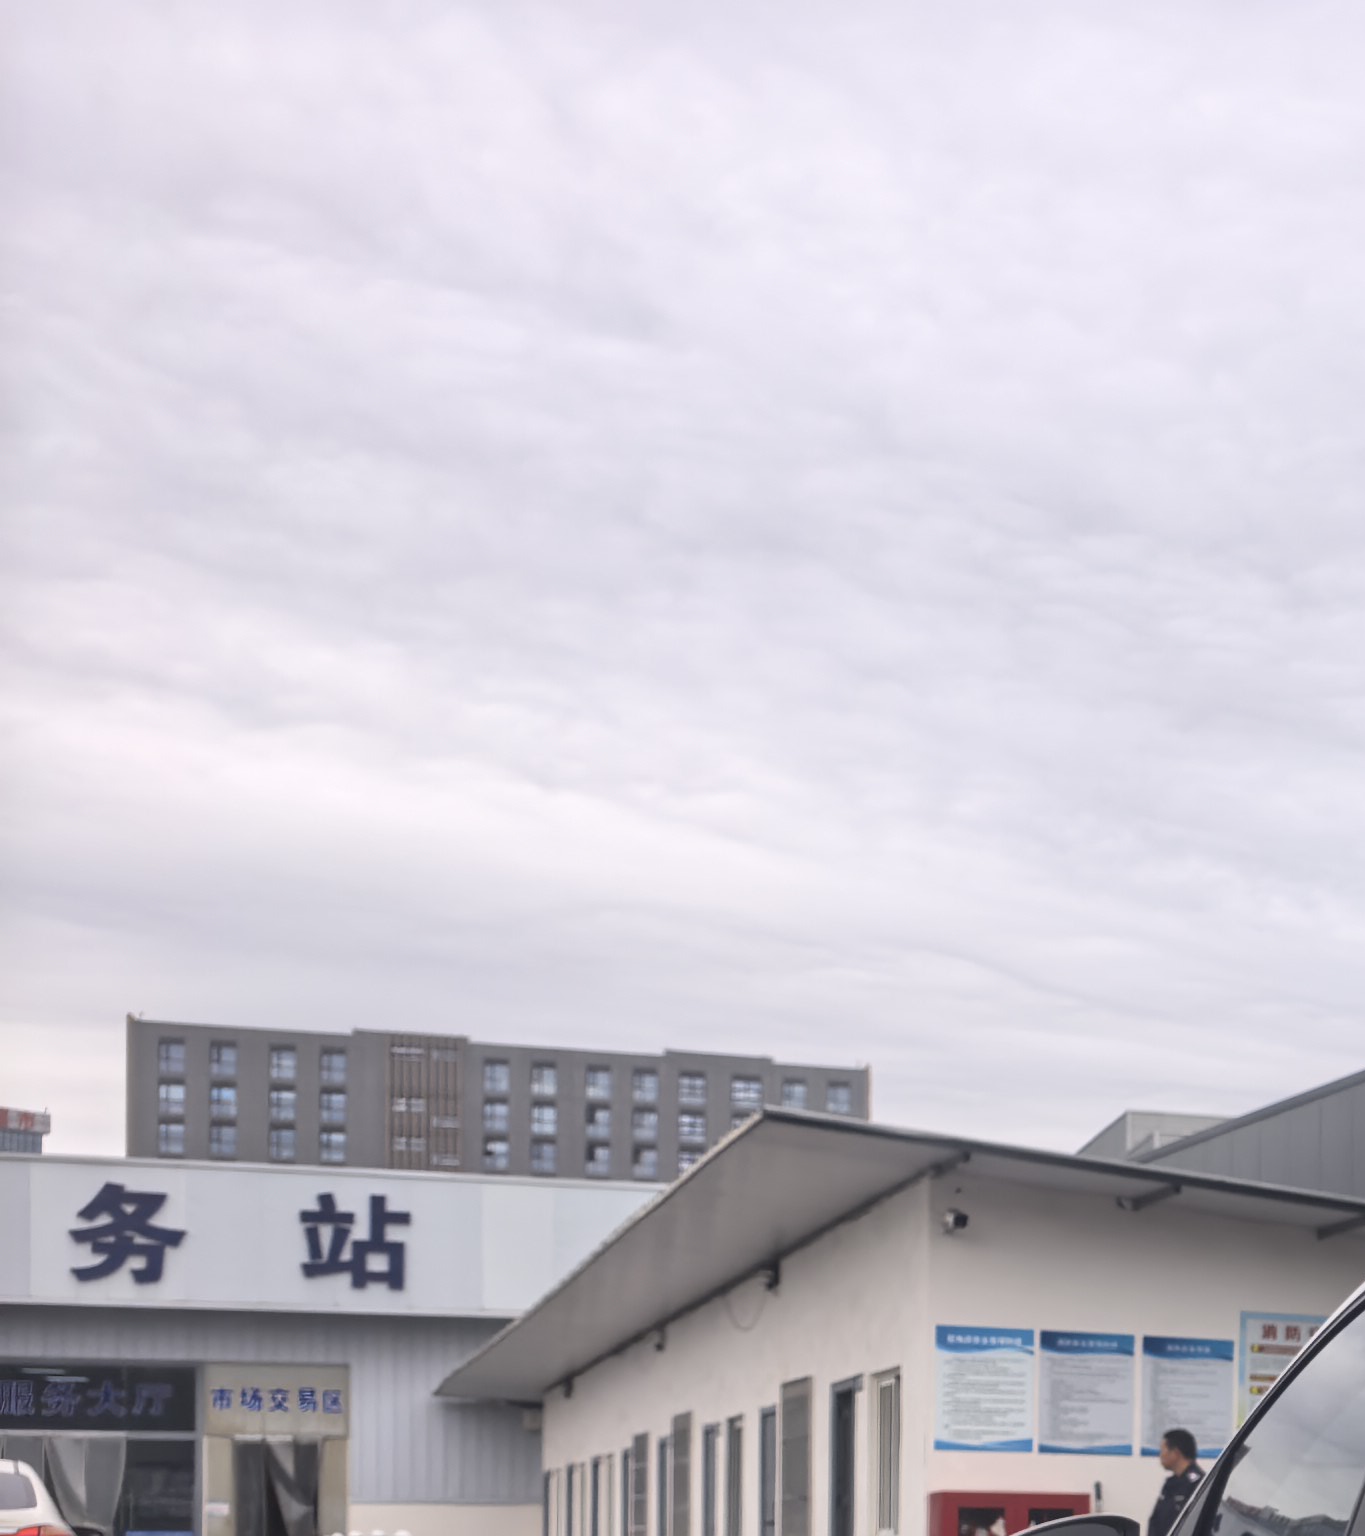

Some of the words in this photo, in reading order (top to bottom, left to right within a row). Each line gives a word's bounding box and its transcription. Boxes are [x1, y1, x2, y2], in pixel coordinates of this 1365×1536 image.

[68, 1182, 411, 1291] 务站
[210, 1387, 343, 1414] 市场交易区
